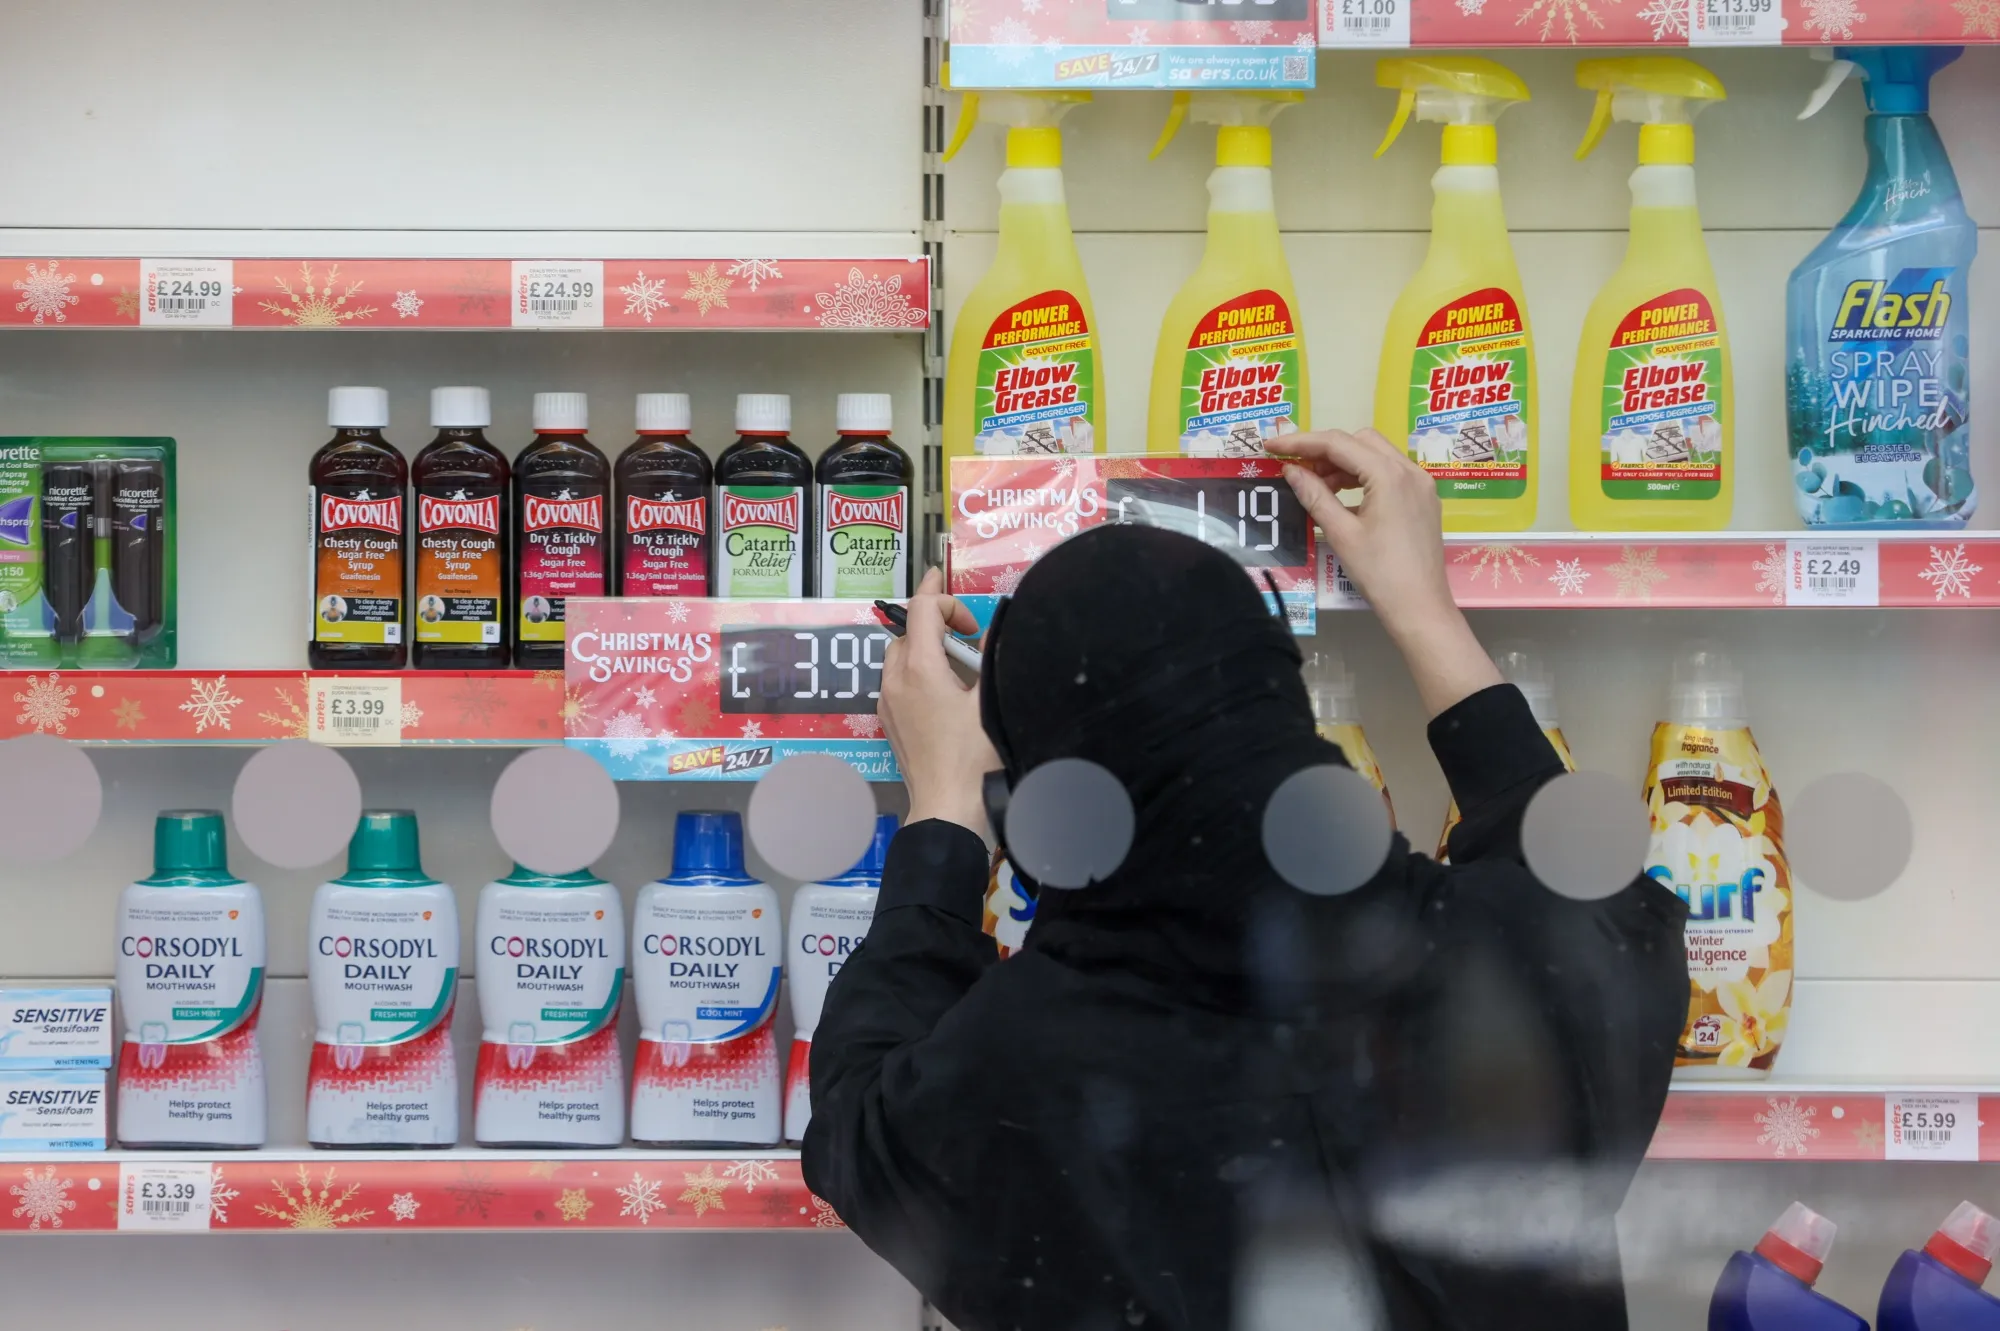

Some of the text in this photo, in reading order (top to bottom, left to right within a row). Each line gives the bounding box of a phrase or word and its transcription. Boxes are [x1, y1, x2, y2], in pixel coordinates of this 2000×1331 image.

[1059, 54, 1158, 78] SAVE 24/7
[1169, 56, 1185, 64] We
[1206, 56, 1239, 67] always
[1241, 57, 1268, 67] open
[1271, 56, 1279, 64] at
[1169, 68, 1278, 81] savers.co.uk
[146, 273, 156, 312] savers
[157, 280, 221, 296] £24.99
[518, 275, 528, 314] savers
[530, 282, 593, 298] £24.99
[1835, 279, 1951, 327] Flash
[1011, 304, 1069, 328] POWER
[1218, 304, 1275, 328] POWER
[1447, 303, 1504, 327] POWER
[1641, 303, 1698, 327] POWER
[993, 321, 1080, 346] PERFORMANCE
[1199, 321, 1286, 346] PERFORMANCE
[1428, 319, 1515, 344] PERFORMANCE
[1622, 320, 1710, 344] PERFORMANCE
[1831, 328, 1941, 339] SPARKLING HOME
[1027, 341, 1086, 356] SOLVENT FREE
[1656, 340, 1715, 354] SOLVENT FREE
[1831, 351, 1942, 378] SPRAY
[995, 364, 1075, 392] Elbow
[1201, 364, 1281, 392] Elbow
[1429, 362, 1510, 391] Elbow
[1623, 362, 1704, 391] Elbow
[995, 385, 1077, 414] Grease
[1200, 385, 1282, 413] Grease
[1429, 383, 1511, 412] Grease
[1623, 384, 1705, 412] Grease
[1832, 379, 1940, 408] WIPE
[984, 406, 1084, 428] ALL PURPOSE DEGREASER
[1824, 396, 1950, 448] Hinched
[1855, 453, 1921, 463] EUCALYPTUS
[1864, 444, 1912, 453] FROSTED
[49, 485, 89, 496] nicorette
[119, 488, 159, 498] nicorette
[420, 498, 497, 529] COVONIA
[526, 498, 600, 528] COVONIA
[726, 499, 794, 525] COVONIA
[831, 498, 899, 524] COVONIA
[958, 488, 1098, 518] CHRISTMAS
[323, 498, 399, 530] COVONIA
[629, 499, 703, 531] COVONIA
[976, 511, 1079, 538] SAVINGS
[1198, 486, 1279, 551] 119
[324, 538, 398, 551] Chesty Cough
[422, 538, 495, 551] Chesty Cough
[530, 533, 596, 546] Dry & Tickly
[633, 534, 700, 548] Dry & Tickly
[725, 533, 796, 556] Catarrh
[830, 532, 901, 555] Catarrh
[337, 551, 385, 560] Sugar Free
[545, 544, 580, 557] Cough
[648, 546, 684, 558] Cough
[852, 551, 901, 571] Relief
[348, 560, 374, 571] Syrup
[540, 559, 565, 568] Sugar
[733, 568, 780, 577] FORMULA
[747, 552, 796, 572] Relief
[838, 567, 885, 575] FORMULA
[1792, 551, 1802, 590] savers
[1807, 560, 1860, 575] £2.49
[340, 573, 381, 581] Guaifenesin
[571, 632, 712, 662] CHRISTMAS
[589, 656, 692, 683] SAVINGS
[315, 692, 325, 730] savers
[332, 699, 384, 714] £3.99
[856, 750, 880, 760] open
[1681, 743, 1719, 754] fragrance
[672, 747, 771, 772] SAVE 24/7
[1689, 761, 1711, 770] natural
[1667, 785, 1733, 800] Limited Edition
[121, 936, 243, 958] CORSODYL
[319, 936, 437, 958] CORSODYL
[491, 936, 608, 958] CORSODYL
[644, 934, 765, 956] CORSODYL
[1689, 936, 1724, 946] Winter
[146, 964, 215, 978] DAILY
[345, 964, 411, 979] DAILY
[670, 962, 739, 978] DAILY
[345, 983, 413, 991] MOUTHWASH
[670, 981, 740, 989] MOUTHWASH
[12, 1008, 106, 1023] SENSITIVE
[700, 1009, 722, 1017] COOL
[43, 1025, 99, 1033] Sensifoam
[1699, 1032, 1715, 1043] 24
[6, 1090, 100, 1105] SENSITIVE
[169, 1100, 231, 1110] Helps protect
[169, 1110, 232, 1120] healthy gums
[1891, 1104, 1901, 1144] savers
[1902, 1112, 1955, 1128] £5.99
[126, 1175, 134, 1215] savers
[142, 1182, 194, 1199] £3.39
